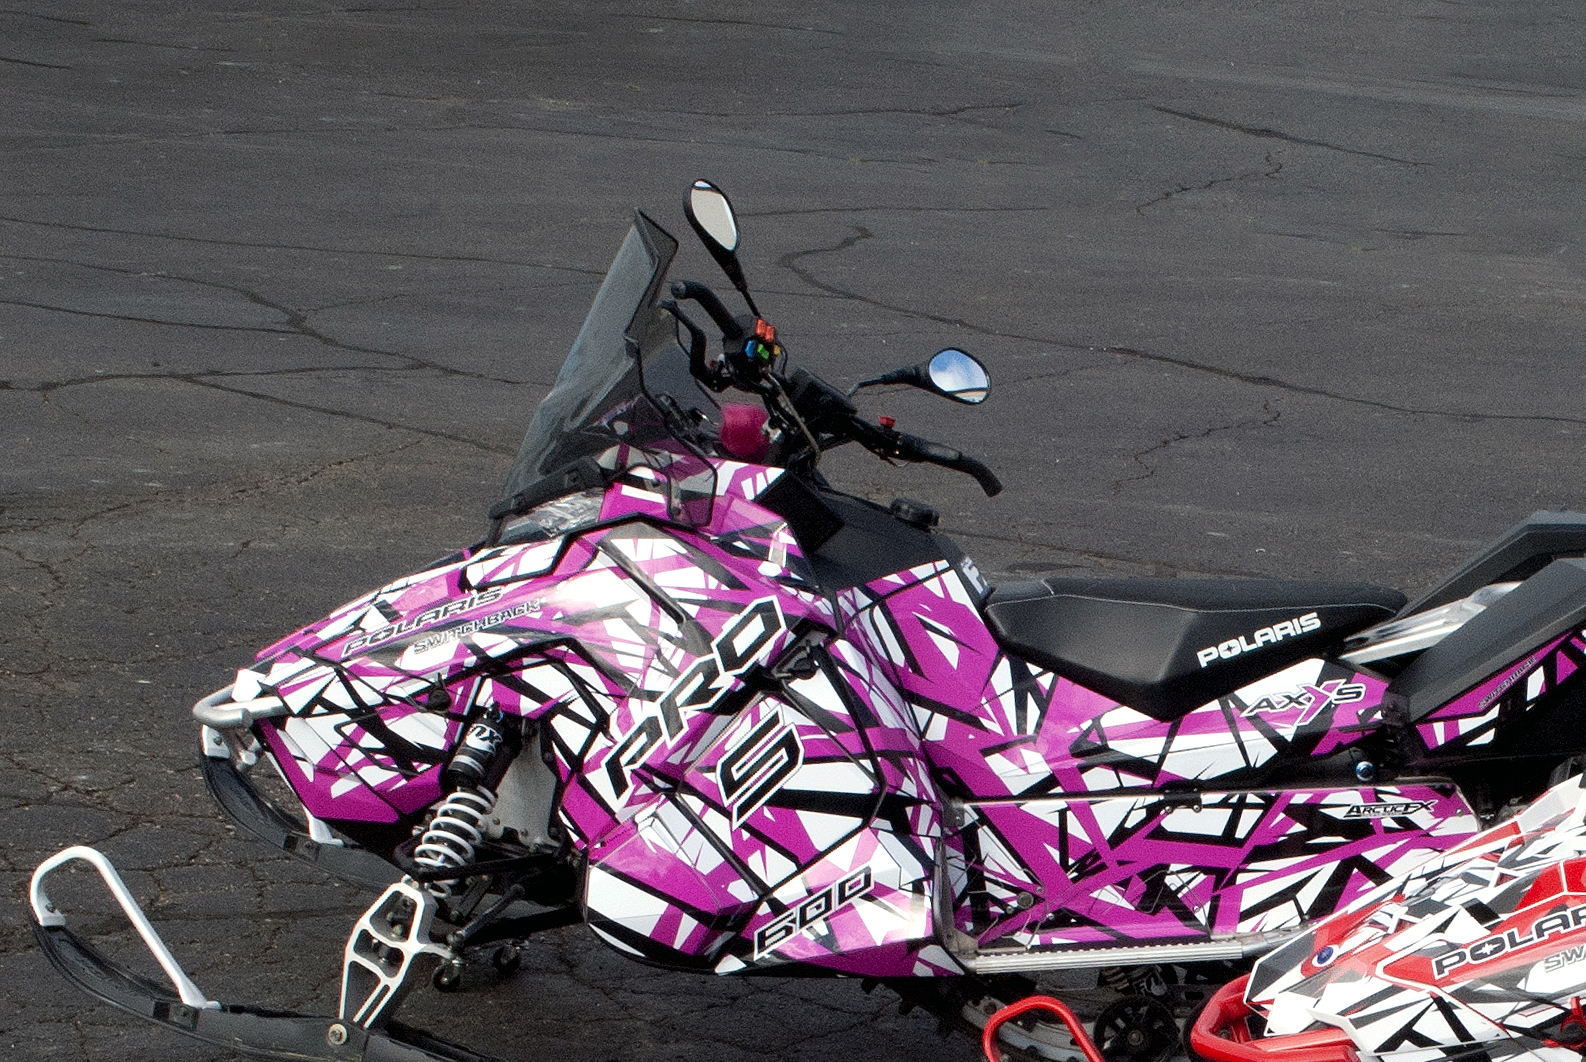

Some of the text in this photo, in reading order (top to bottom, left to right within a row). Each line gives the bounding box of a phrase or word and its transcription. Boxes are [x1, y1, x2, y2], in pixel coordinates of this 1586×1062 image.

[341, 588, 503, 658] POLARIS
[413, 599, 542, 655] SWITCHBACK
[1197, 612, 1321, 668] POLARIS
[603, 596, 787, 806] PRO
[1241, 679, 1366, 727] AXYS
[754, 863, 873, 960] 600
